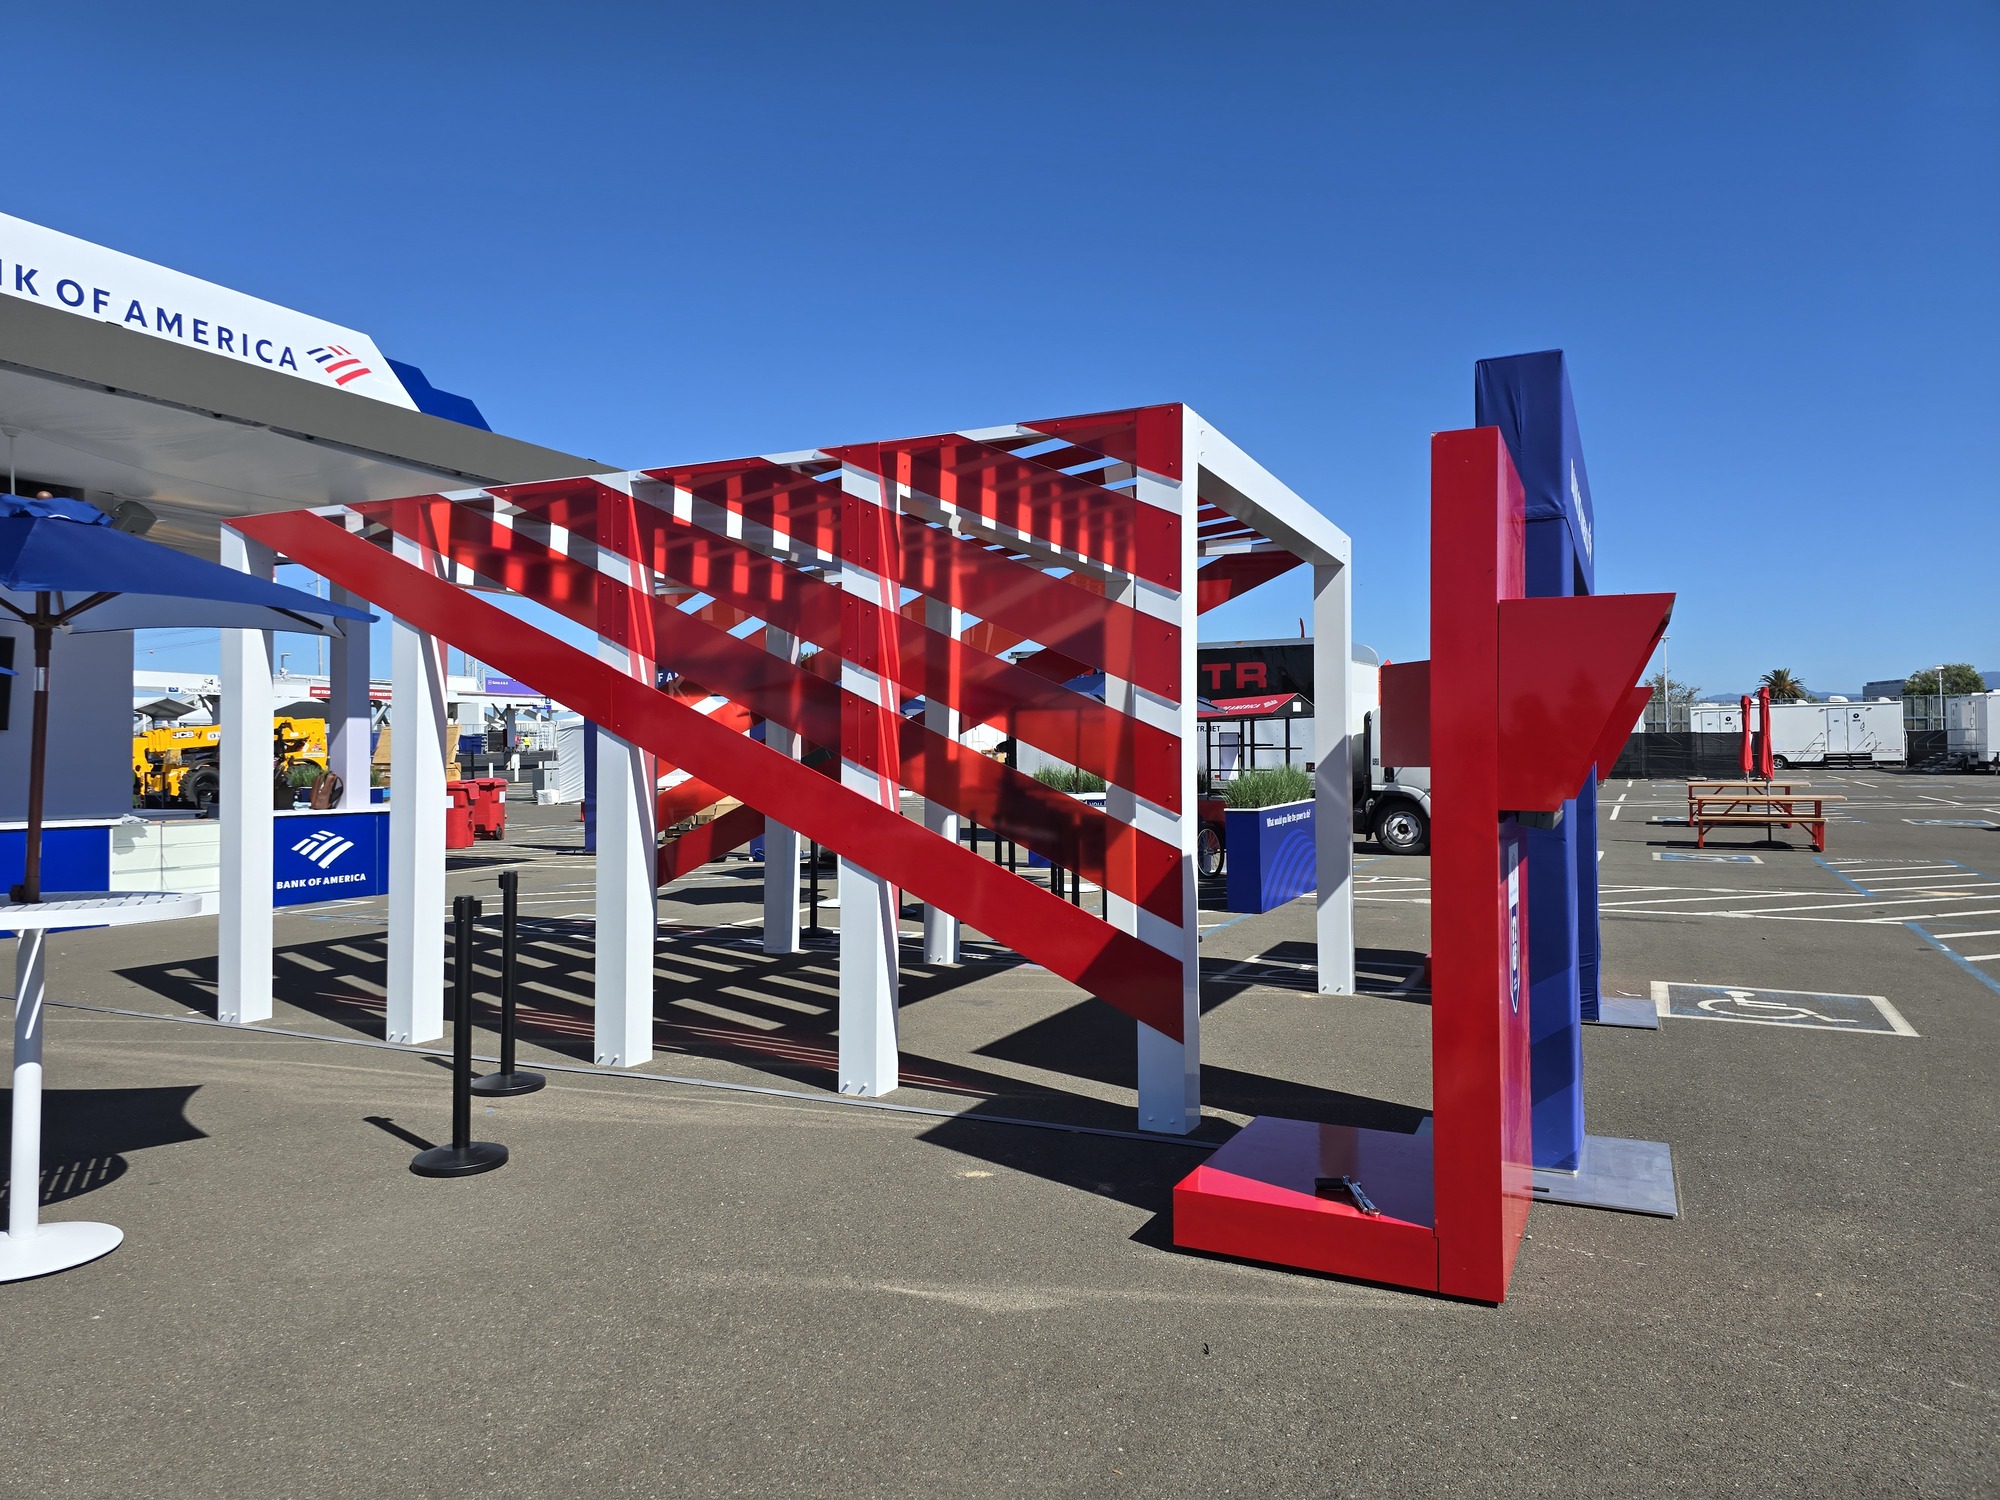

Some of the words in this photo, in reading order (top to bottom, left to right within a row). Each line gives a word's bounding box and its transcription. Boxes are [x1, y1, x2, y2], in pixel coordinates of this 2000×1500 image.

[0, 258, 39, 297] K
[56, 278, 110, 314] OF
[124, 299, 298, 372] AMERICA
[172, 731, 194, 739] JCB
[276, 879, 306, 890] BANK
[308, 877, 322, 887] OF
[323, 872, 366, 885] AMERICA
